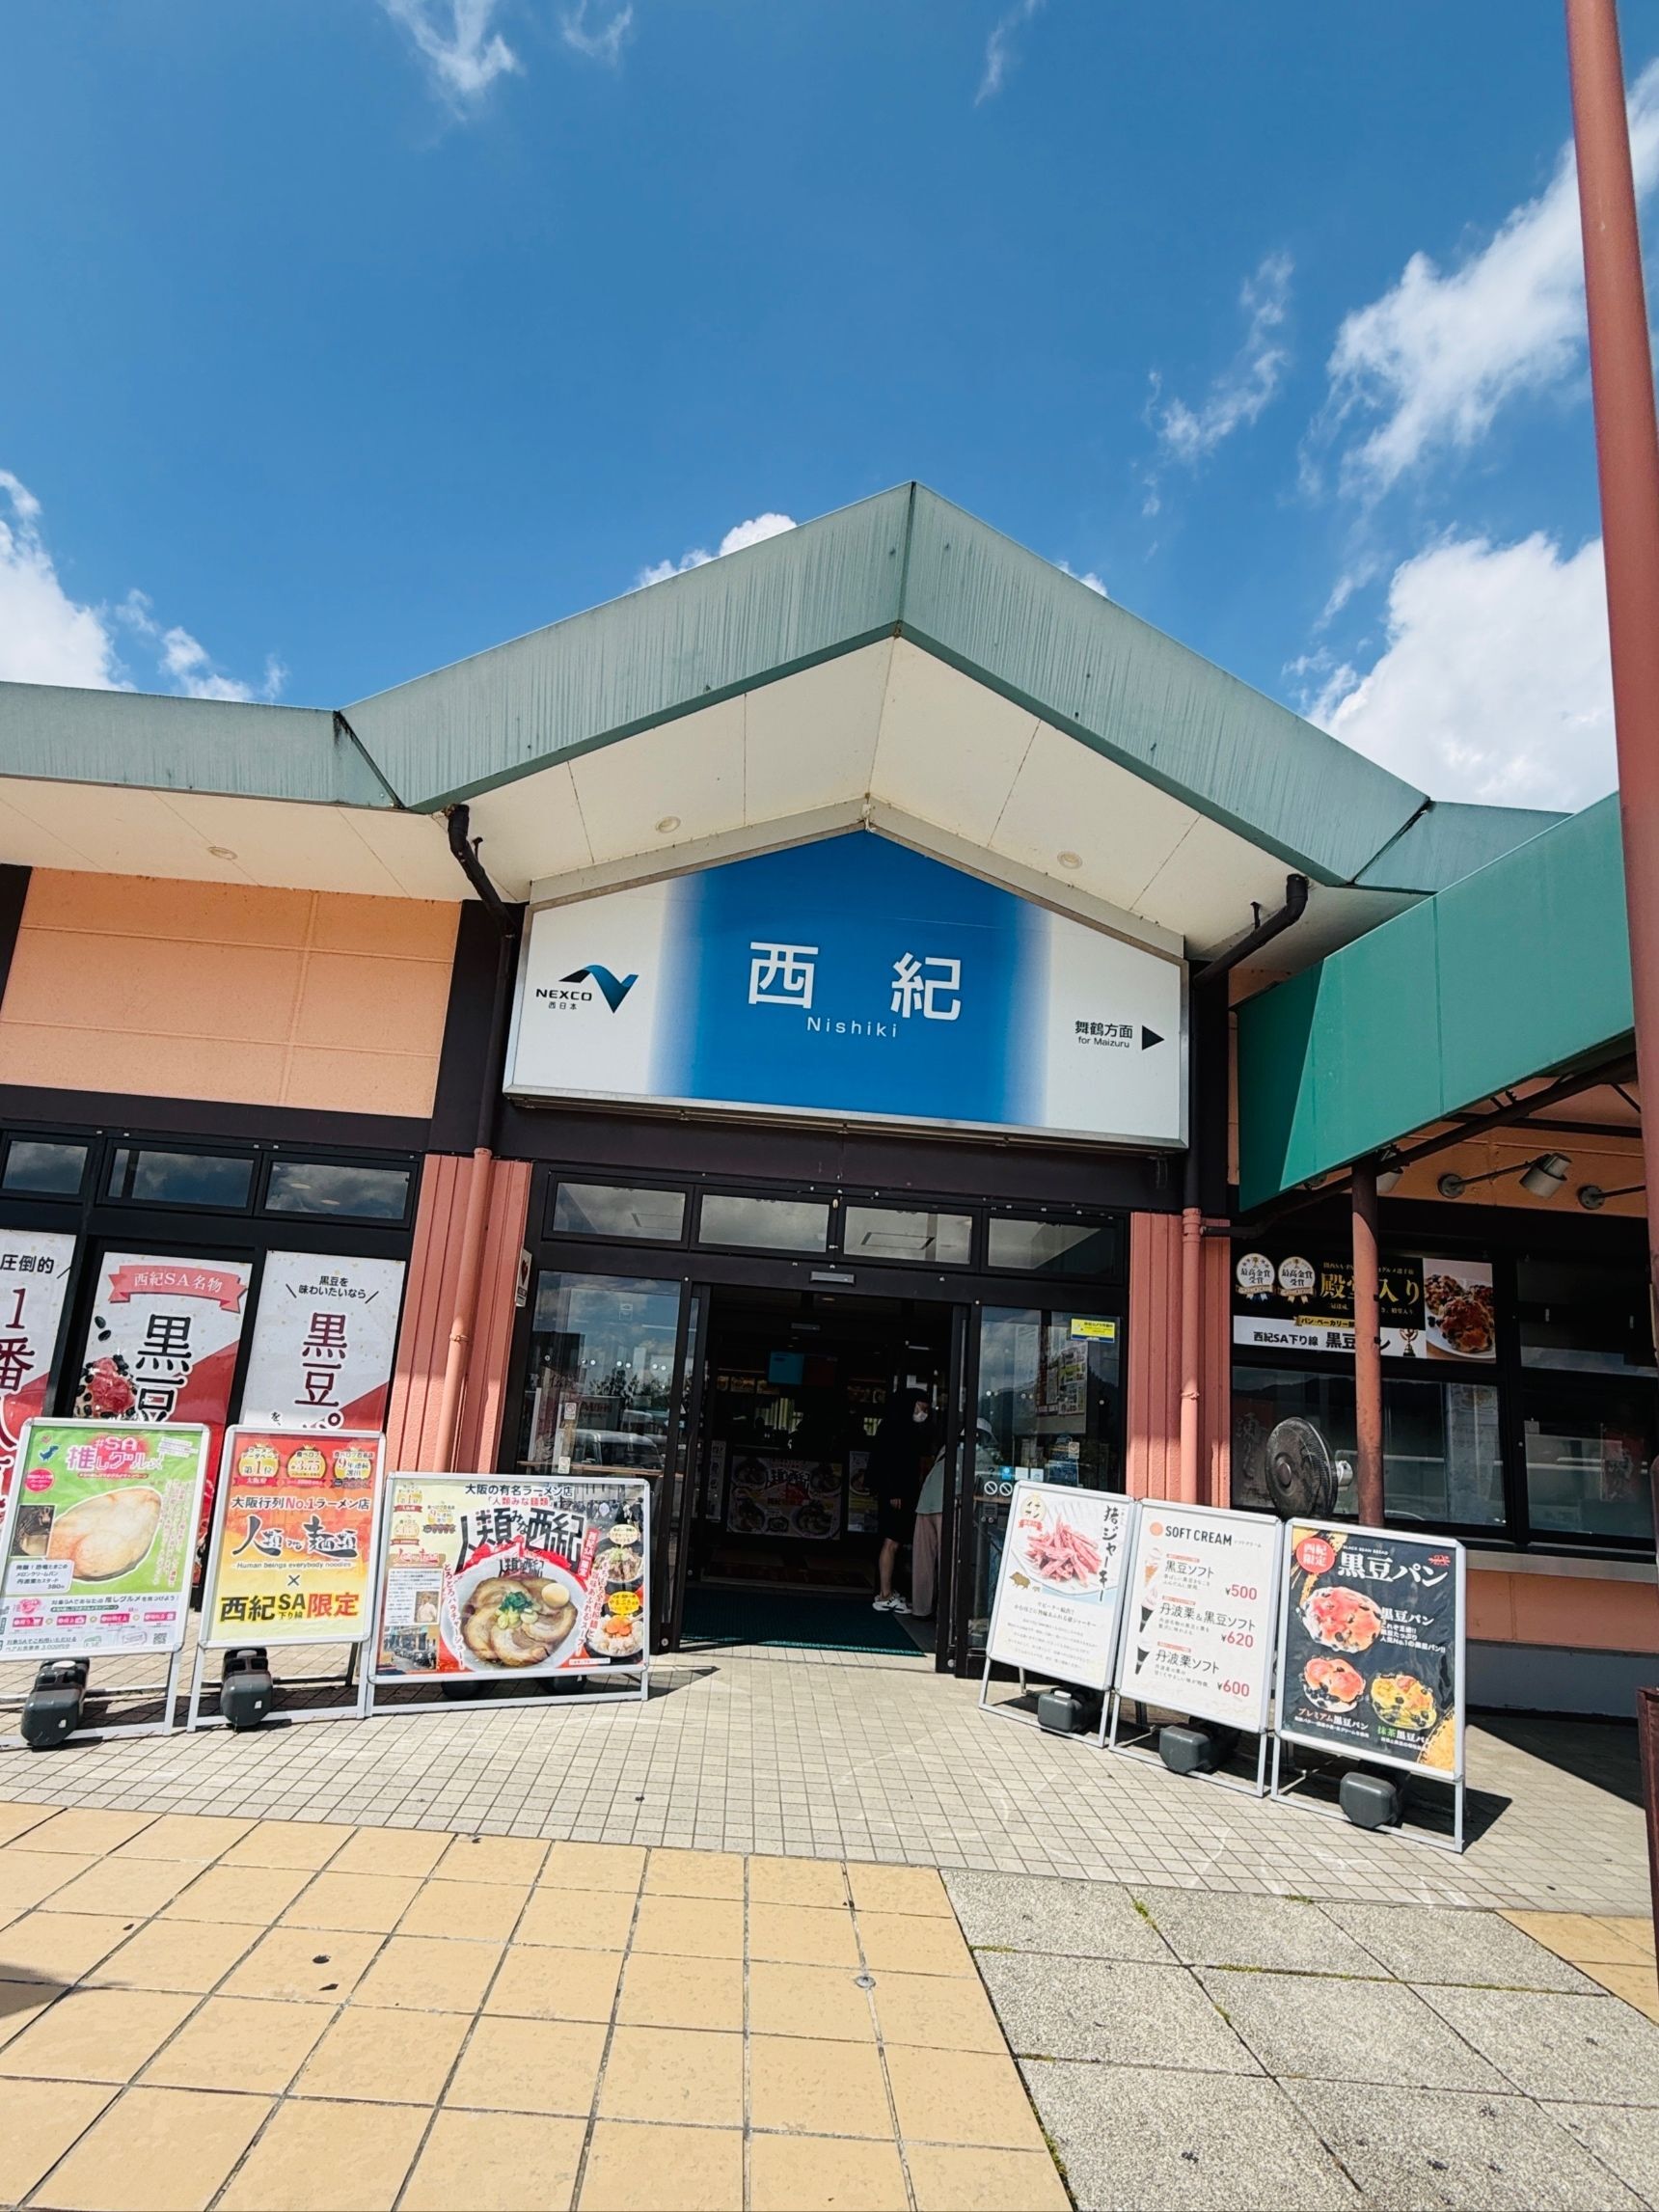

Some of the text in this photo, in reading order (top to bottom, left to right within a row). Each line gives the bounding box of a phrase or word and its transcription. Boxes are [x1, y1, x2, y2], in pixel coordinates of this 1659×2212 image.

[748, 942, 962, 1021] 西紀
[536, 988, 592, 1001] NEXCO
[549, 1001, 577, 1010] 西日本
[807, 1017, 897, 1038] Nishiki
[1075, 1021, 1133, 1039] 舞鶴方面
[1078, 1036, 1130, 1049] for Maizuru
[1240, 1268, 1270, 1278] 最高金賞
[1282, 1270, 1313, 1279] 最高金賞
[134, 1272, 223, 1293] 西紀SA名物
[319, 1275, 349, 1287] 黒豆を
[1250, 1276, 1264, 1285] 受賞
[1291, 1278, 1304, 1287] 受賞
[299, 1285, 367, 1298] 味わいたいなら
[1253, 1332, 1319, 1346] 西紀SA下り線
[95, 1436, 138, 1451] #SA
[465, 1484, 573, 1497] 大阪の有名ラーメン店
[231, 1497, 370, 1510] 大阪行列No.1ラーメン店
[1165, 1525, 1232, 1546] SOFT CREAM
[1303, 1556, 1326, 1568] 限定
[1165, 1560, 1214, 1579] 黒豆ソフト
[1338, 1552, 1448, 1587] 黒豆パン
[1226, 1584, 1258, 1600] ¥500
[1222, 1631, 1254, 1648] ¥620
[1156, 1650, 1219, 1674] 丹波栗ソフト
[1217, 1679, 1250, 1697] ¥600
